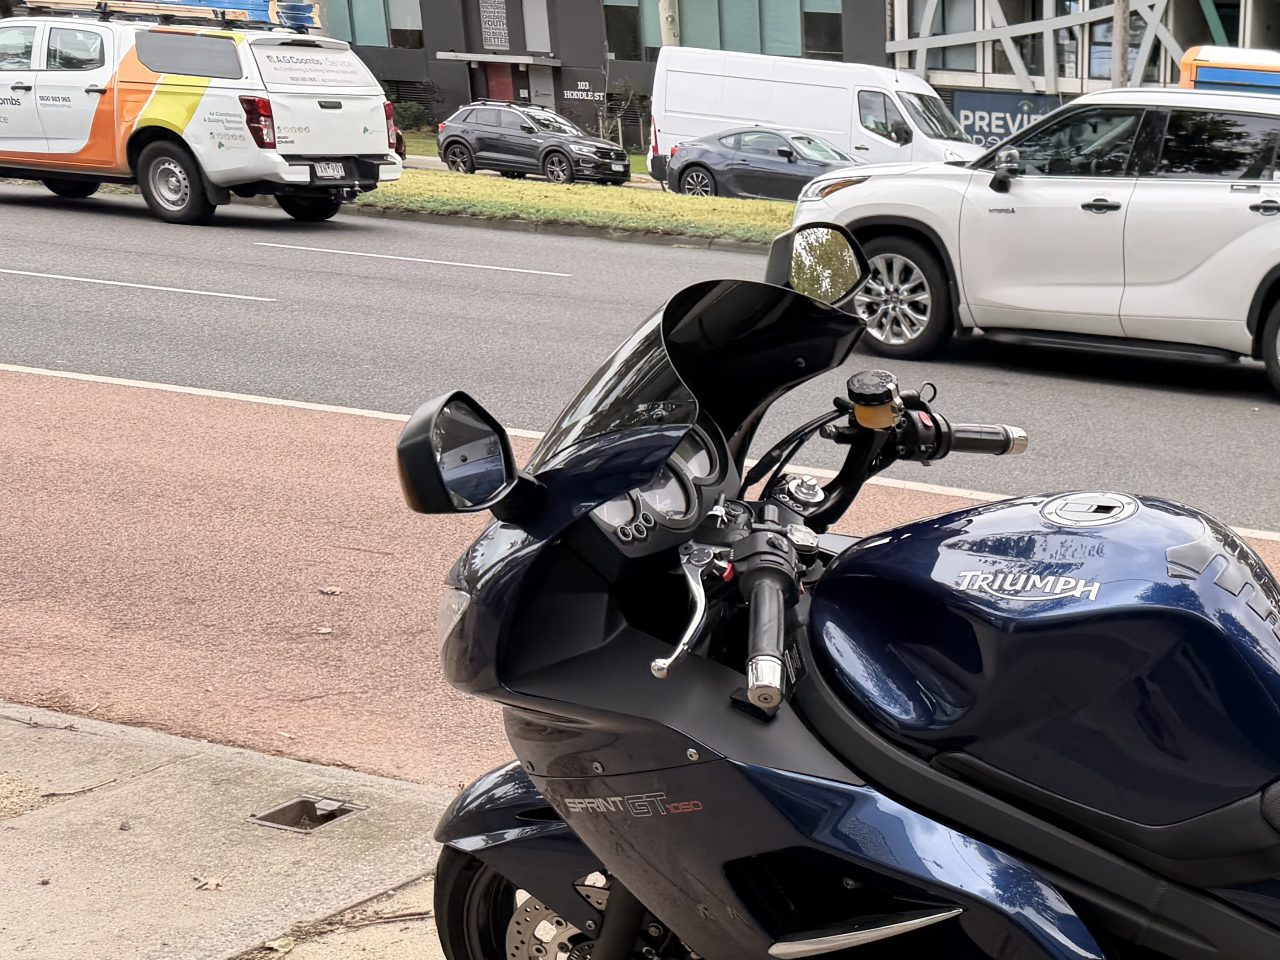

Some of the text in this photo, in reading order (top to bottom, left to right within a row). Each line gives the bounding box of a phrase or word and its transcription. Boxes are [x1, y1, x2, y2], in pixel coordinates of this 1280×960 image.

[577, 81, 589, 89] 103
[564, 90, 604, 100] HODDLE ST
[958, 571, 1100, 601] TRIUMPH
[564, 796, 623, 813] SPRINT
[624, 791, 667, 817] GT
